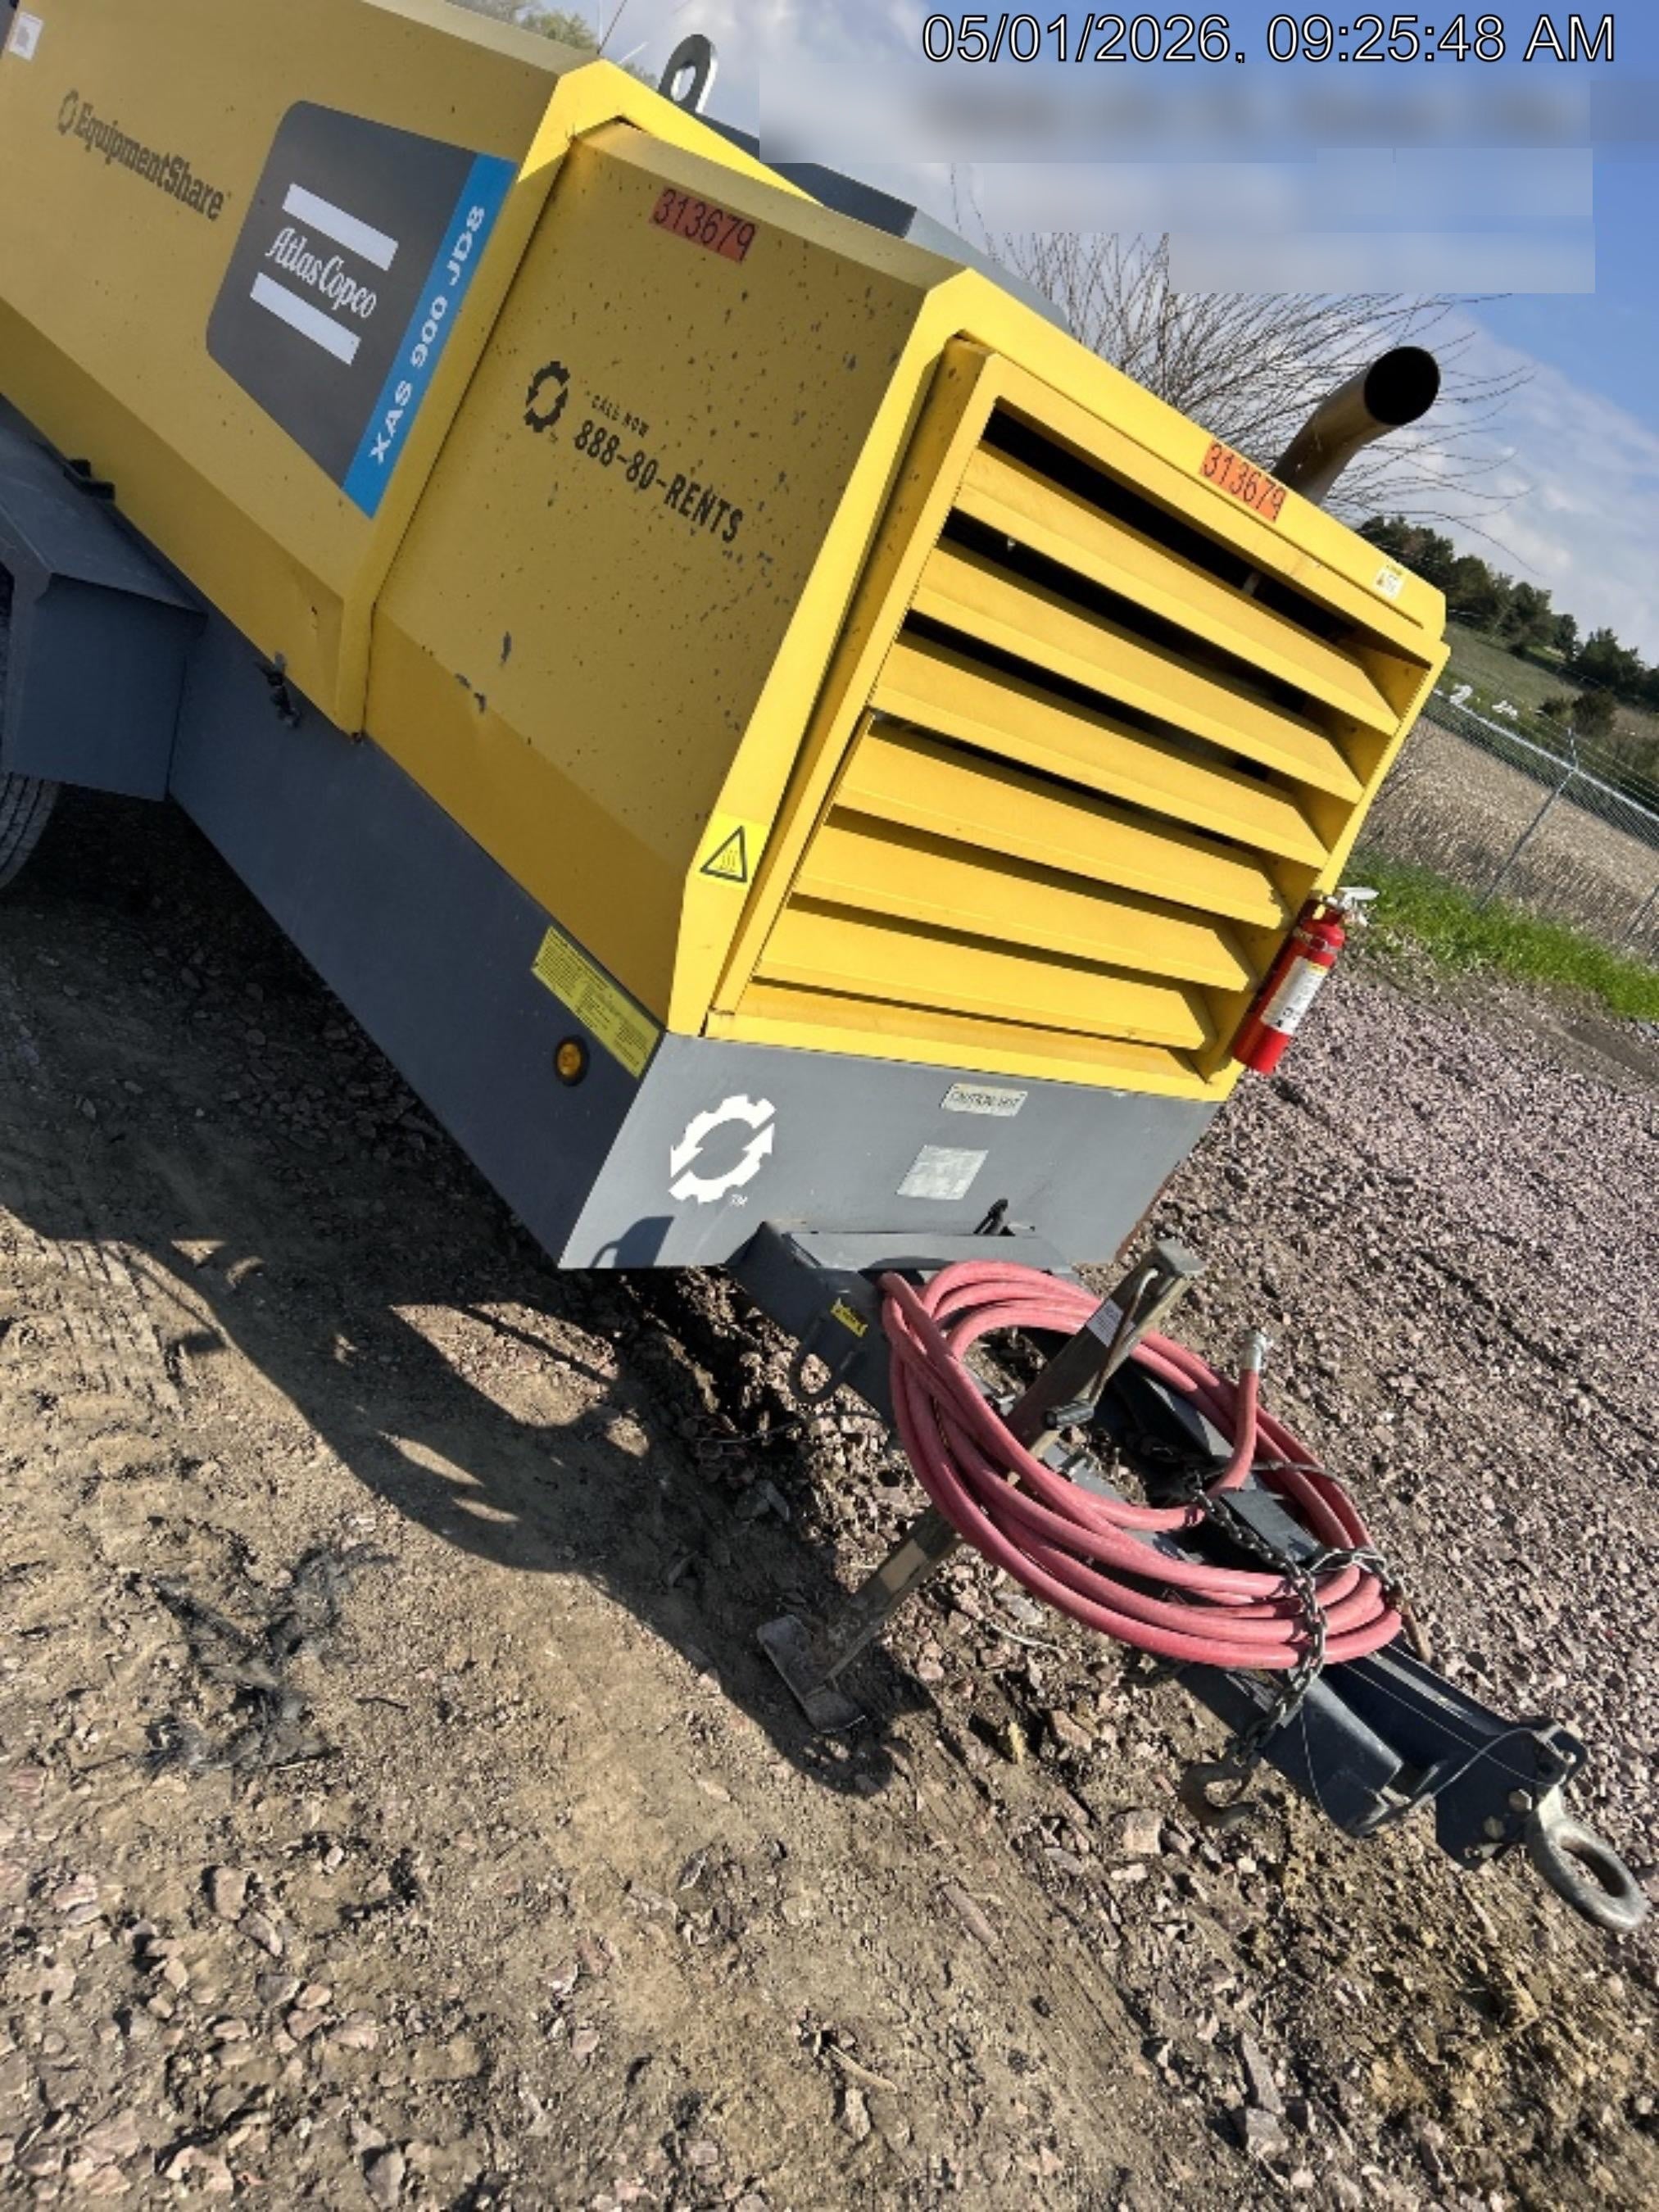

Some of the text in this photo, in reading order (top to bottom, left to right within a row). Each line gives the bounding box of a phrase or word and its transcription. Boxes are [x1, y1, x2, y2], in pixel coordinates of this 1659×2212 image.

[74, 101, 224, 222] EquipmentShare
[654, 188, 756, 264] 313679
[369, 206, 485, 465] XAS 900 JD8
[622, 411, 650, 437] NOW
[573, 419, 744, 542] 888-80-RENTS
[1203, 442, 1286, 523] 313679
